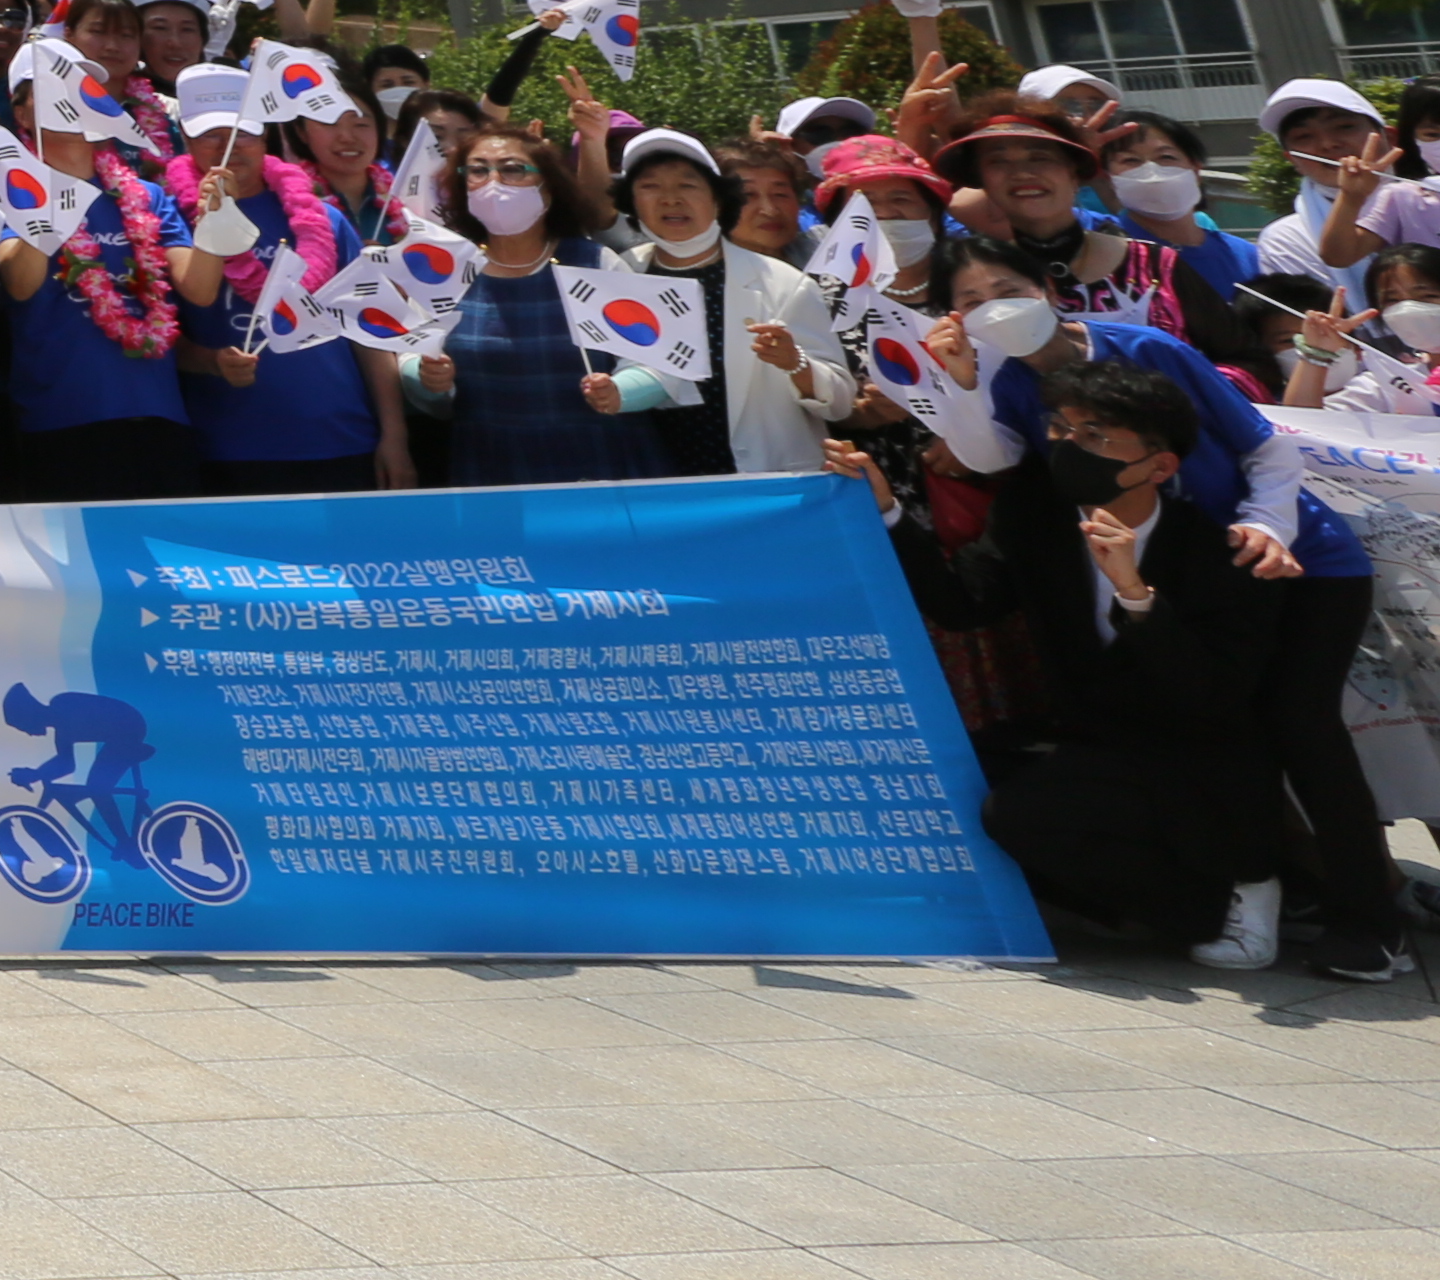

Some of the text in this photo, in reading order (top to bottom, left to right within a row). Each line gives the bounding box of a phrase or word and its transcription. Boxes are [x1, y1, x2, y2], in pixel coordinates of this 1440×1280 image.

[225, 555, 536, 591] 피스로드2022실행위원회
[244, 592, 559, 631] (사)남북통일운동국민연합
[555, 586, 671, 620] 거제시회
[868, 773, 948, 801] 경남지회
[264, 814, 377, 841] 평화대사협의회
[450, 815, 568, 841] 바르게살기운동
[876, 809, 963, 838] 선문대학교
[269, 848, 374, 875] 한일해저터널
[797, 845, 977, 875] 거제시여성단체협의회
[71, 903, 197, 929] PEACE BIKE
